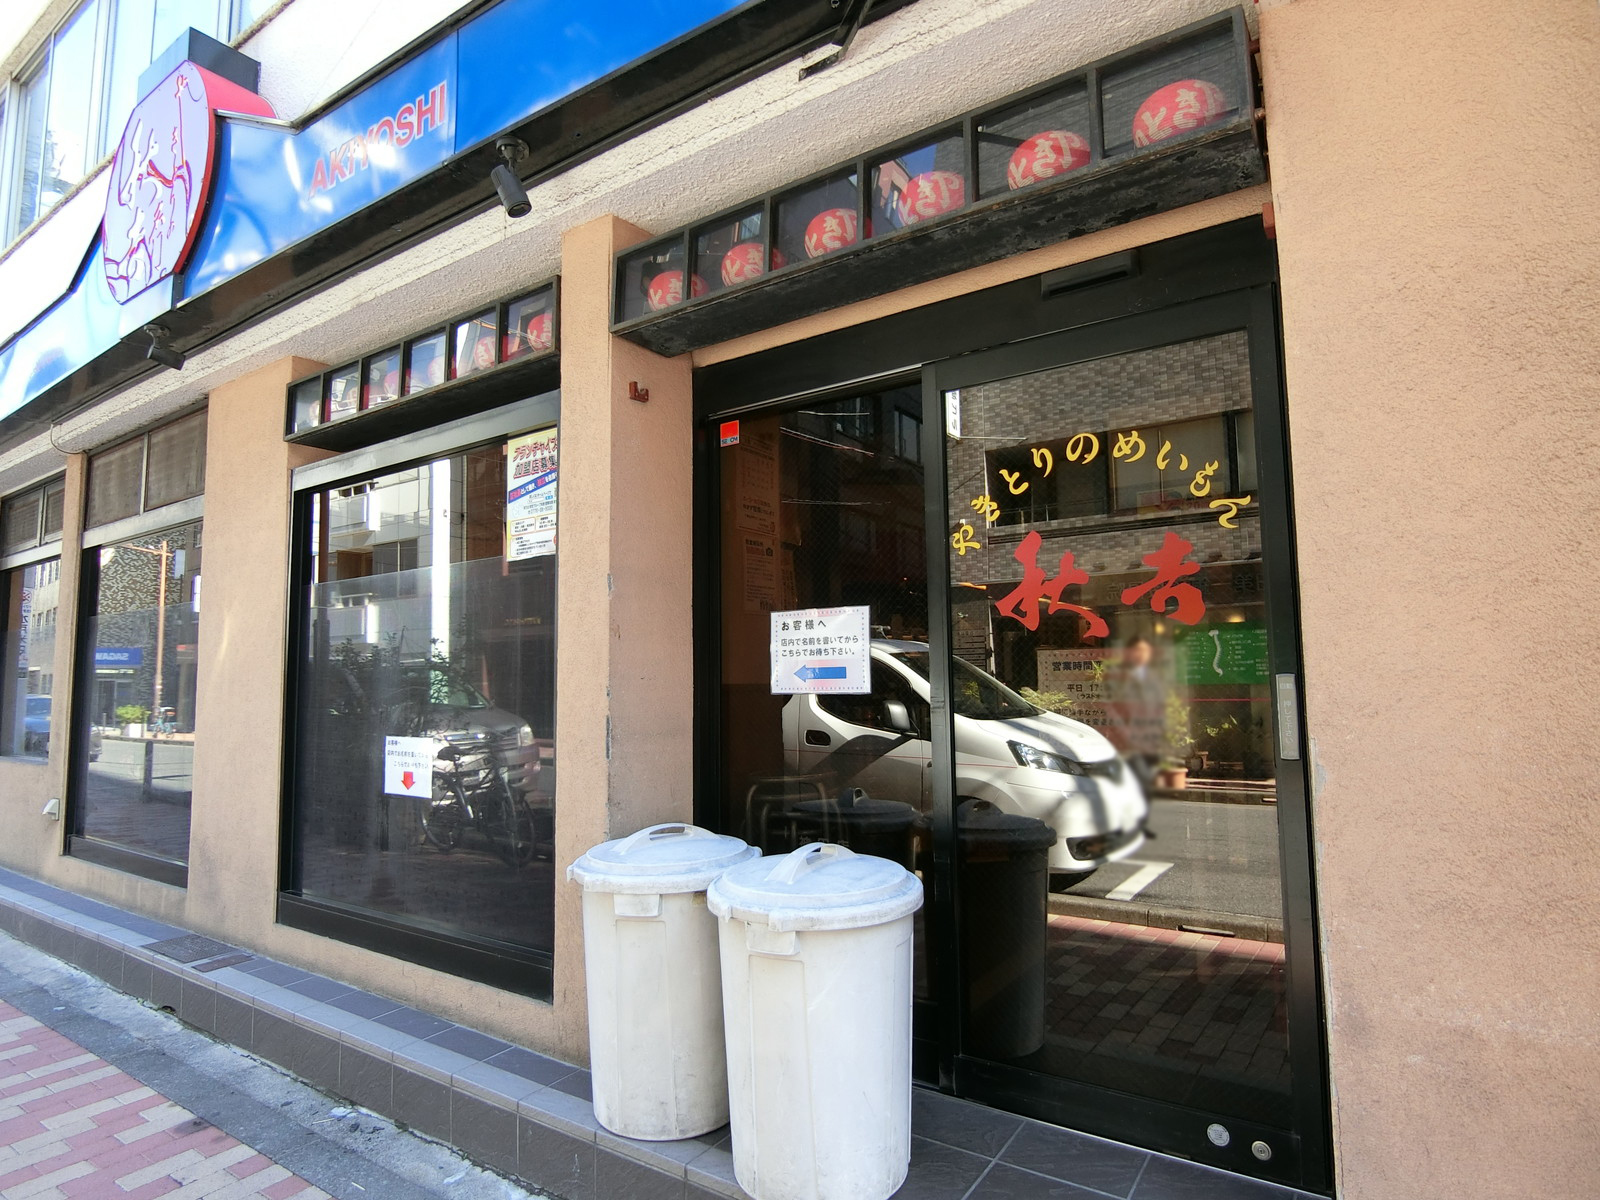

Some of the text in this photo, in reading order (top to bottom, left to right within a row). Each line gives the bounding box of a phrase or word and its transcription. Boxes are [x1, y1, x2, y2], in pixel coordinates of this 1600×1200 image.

[307, 79, 447, 199] AKIYOSHI
[994, 530, 1207, 638] 秋吉
[781, 619, 827, 631] お客様へ
[780, 635, 859, 647] 店内で名前を書いてから
[781, 647, 855, 657] こちらでお待ち下さい。
[1067, 683, 1083, 692] 平日
